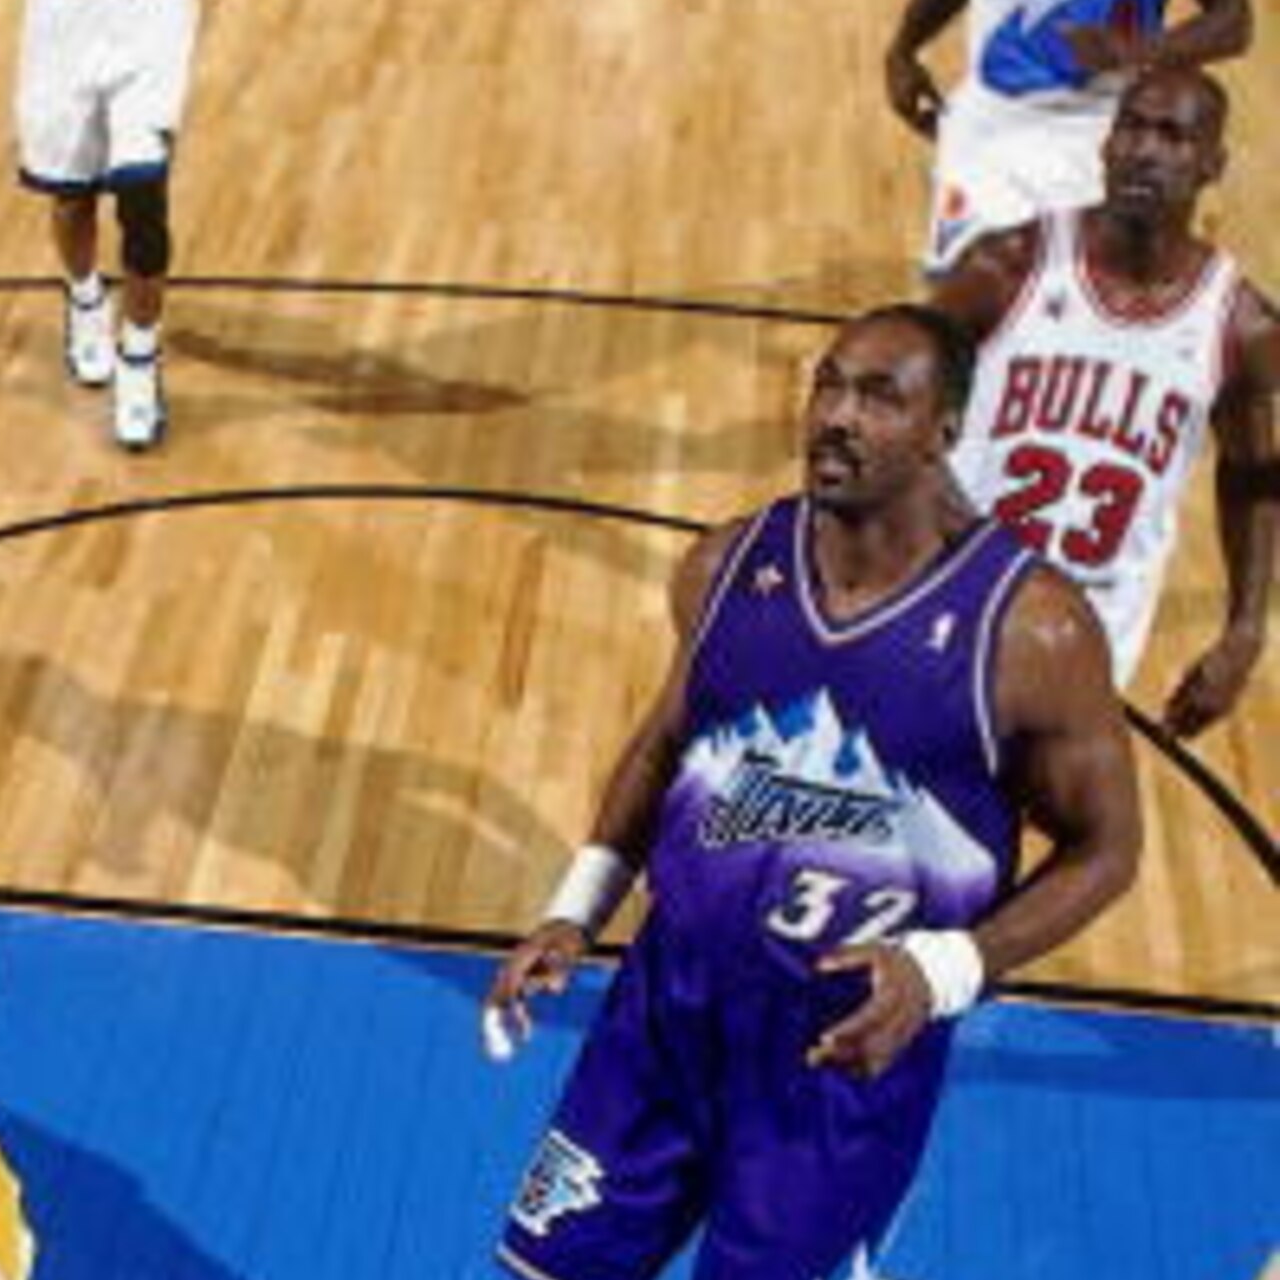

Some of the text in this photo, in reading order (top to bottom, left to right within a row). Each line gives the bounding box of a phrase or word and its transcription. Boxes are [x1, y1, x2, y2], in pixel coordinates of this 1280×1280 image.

[991, 353, 1190, 477] BULLS
[993, 437, 1144, 569] 23
[766, 867, 920, 944] 32
